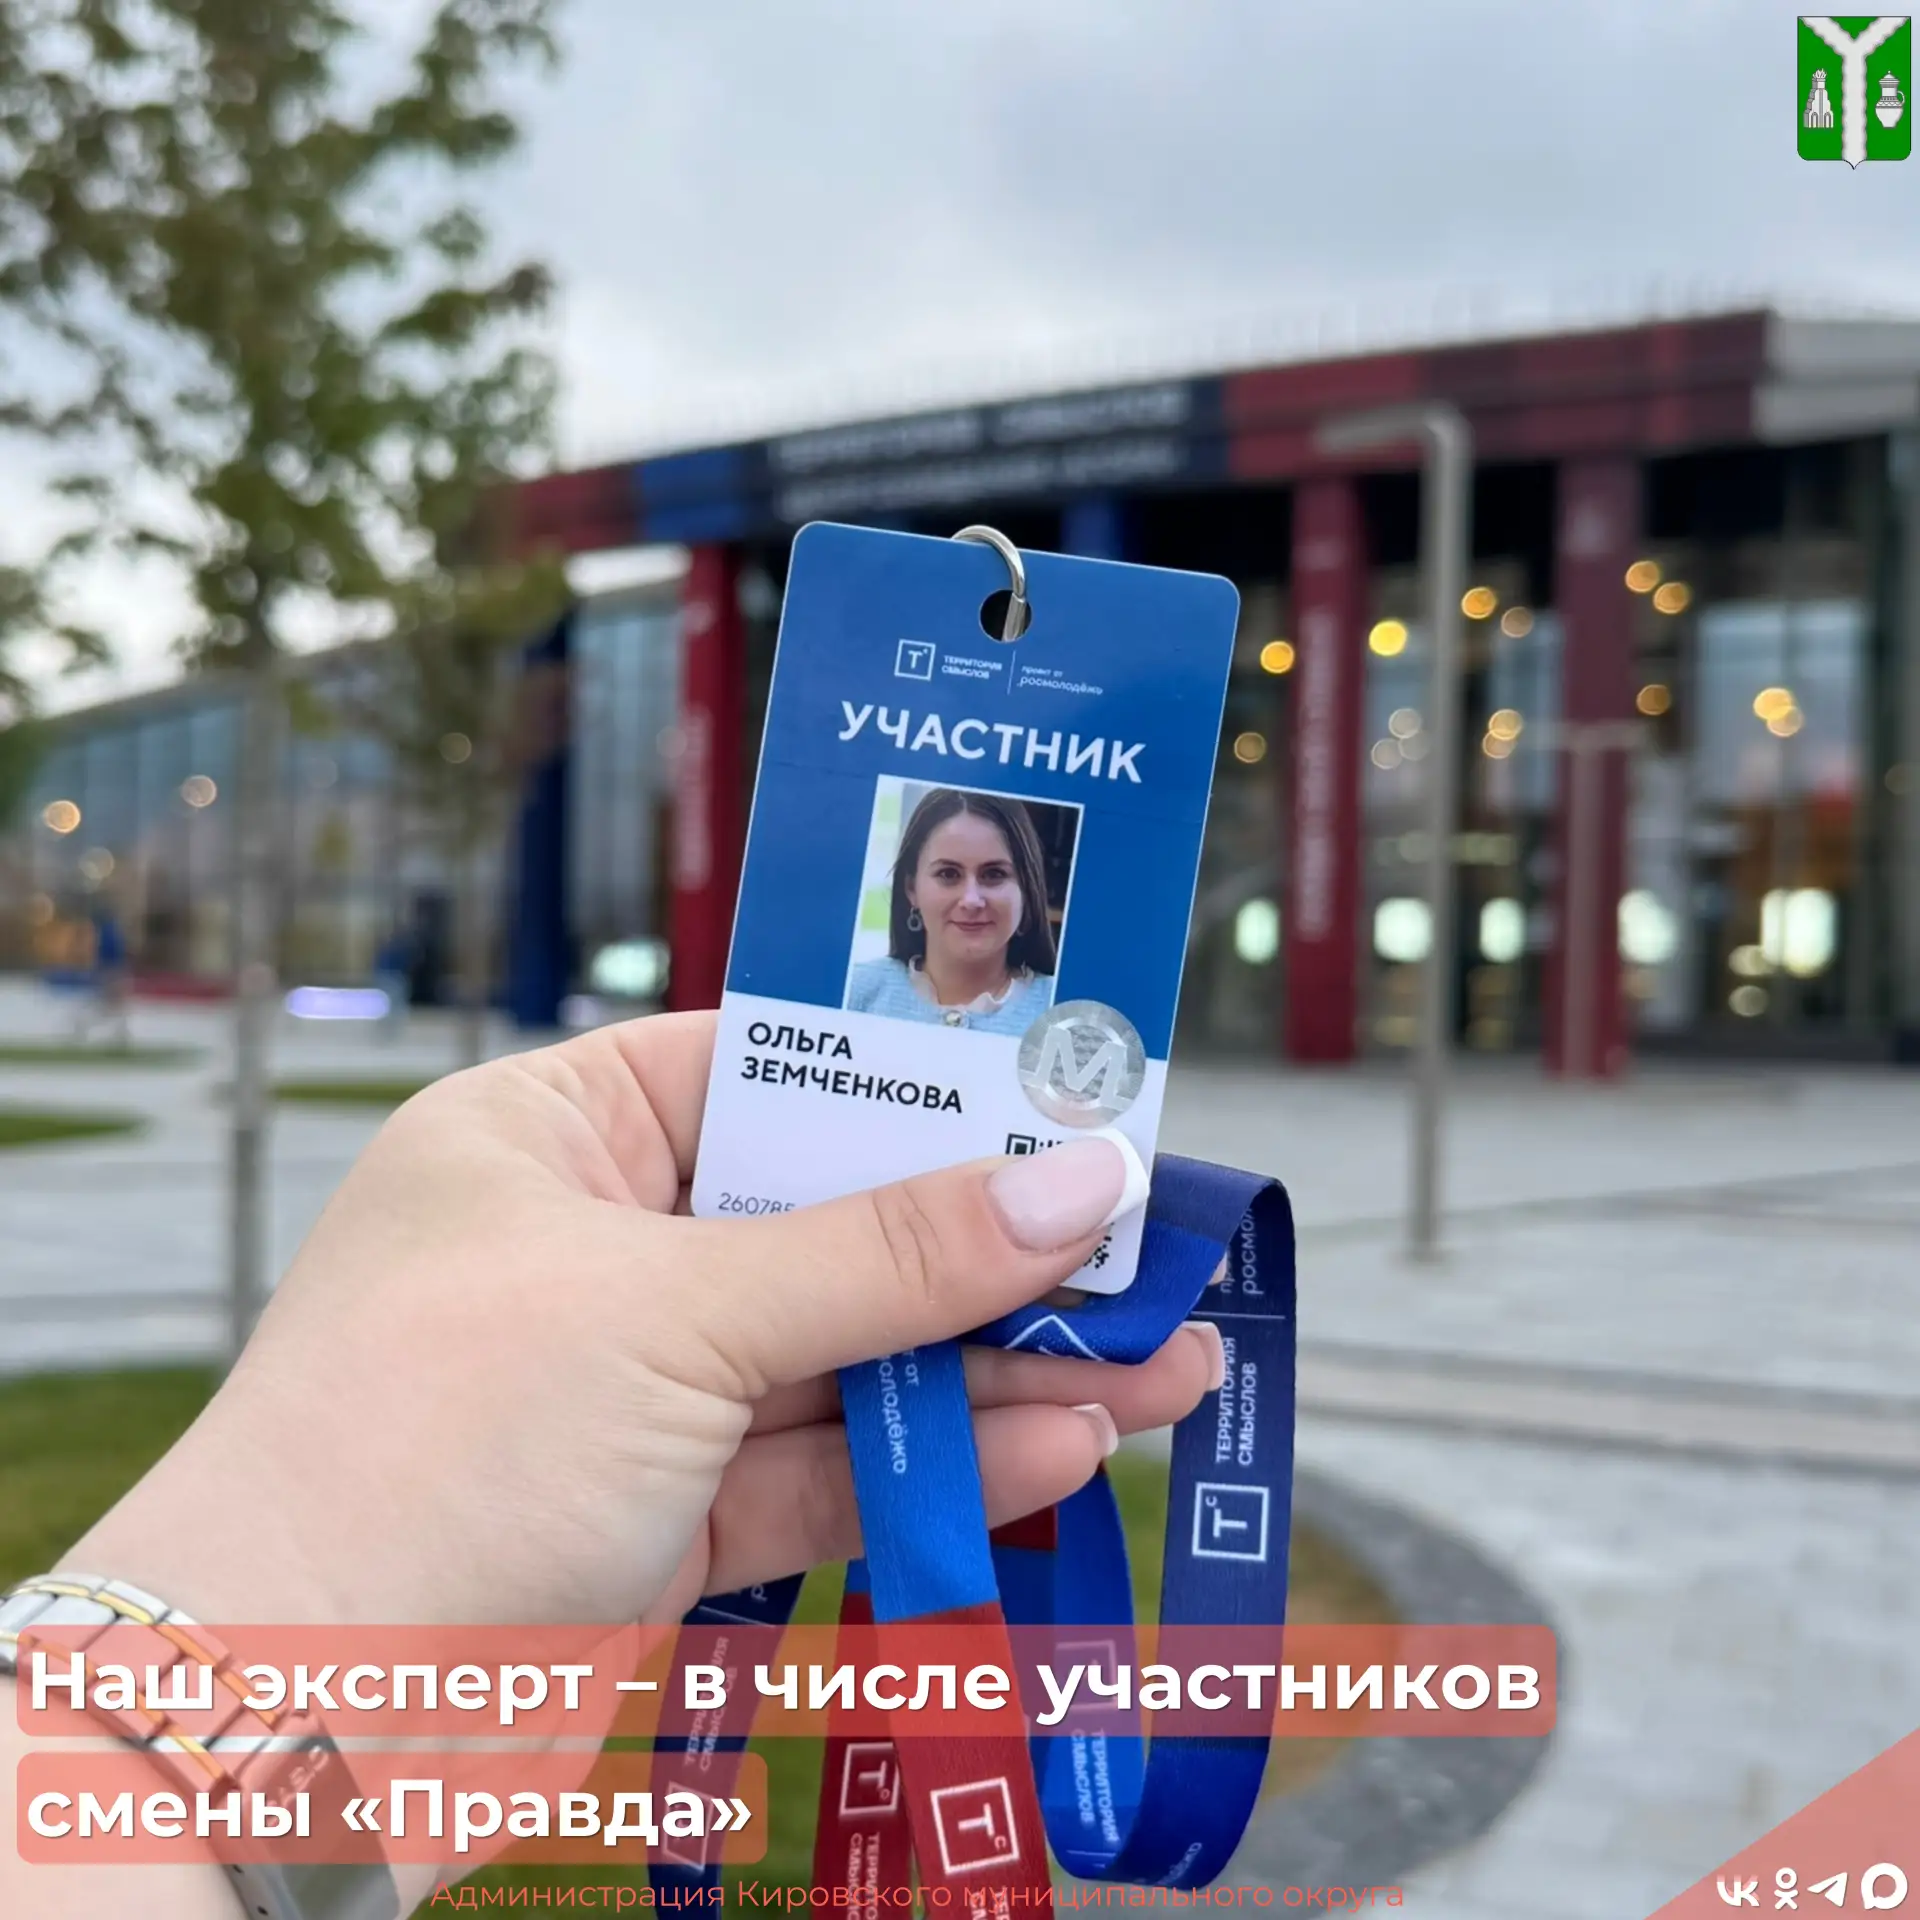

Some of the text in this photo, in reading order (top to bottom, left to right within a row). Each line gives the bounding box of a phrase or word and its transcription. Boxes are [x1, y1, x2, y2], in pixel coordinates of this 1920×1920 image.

[838, 701, 1146, 784] УЧАСТНИК
[747, 1021, 853, 1060] ОЛЬГА
[740, 1056, 963, 1114] ЗЕМЧЕНКОВА
[1237, 1362, 1257, 1466] СМЫСЛОВ
